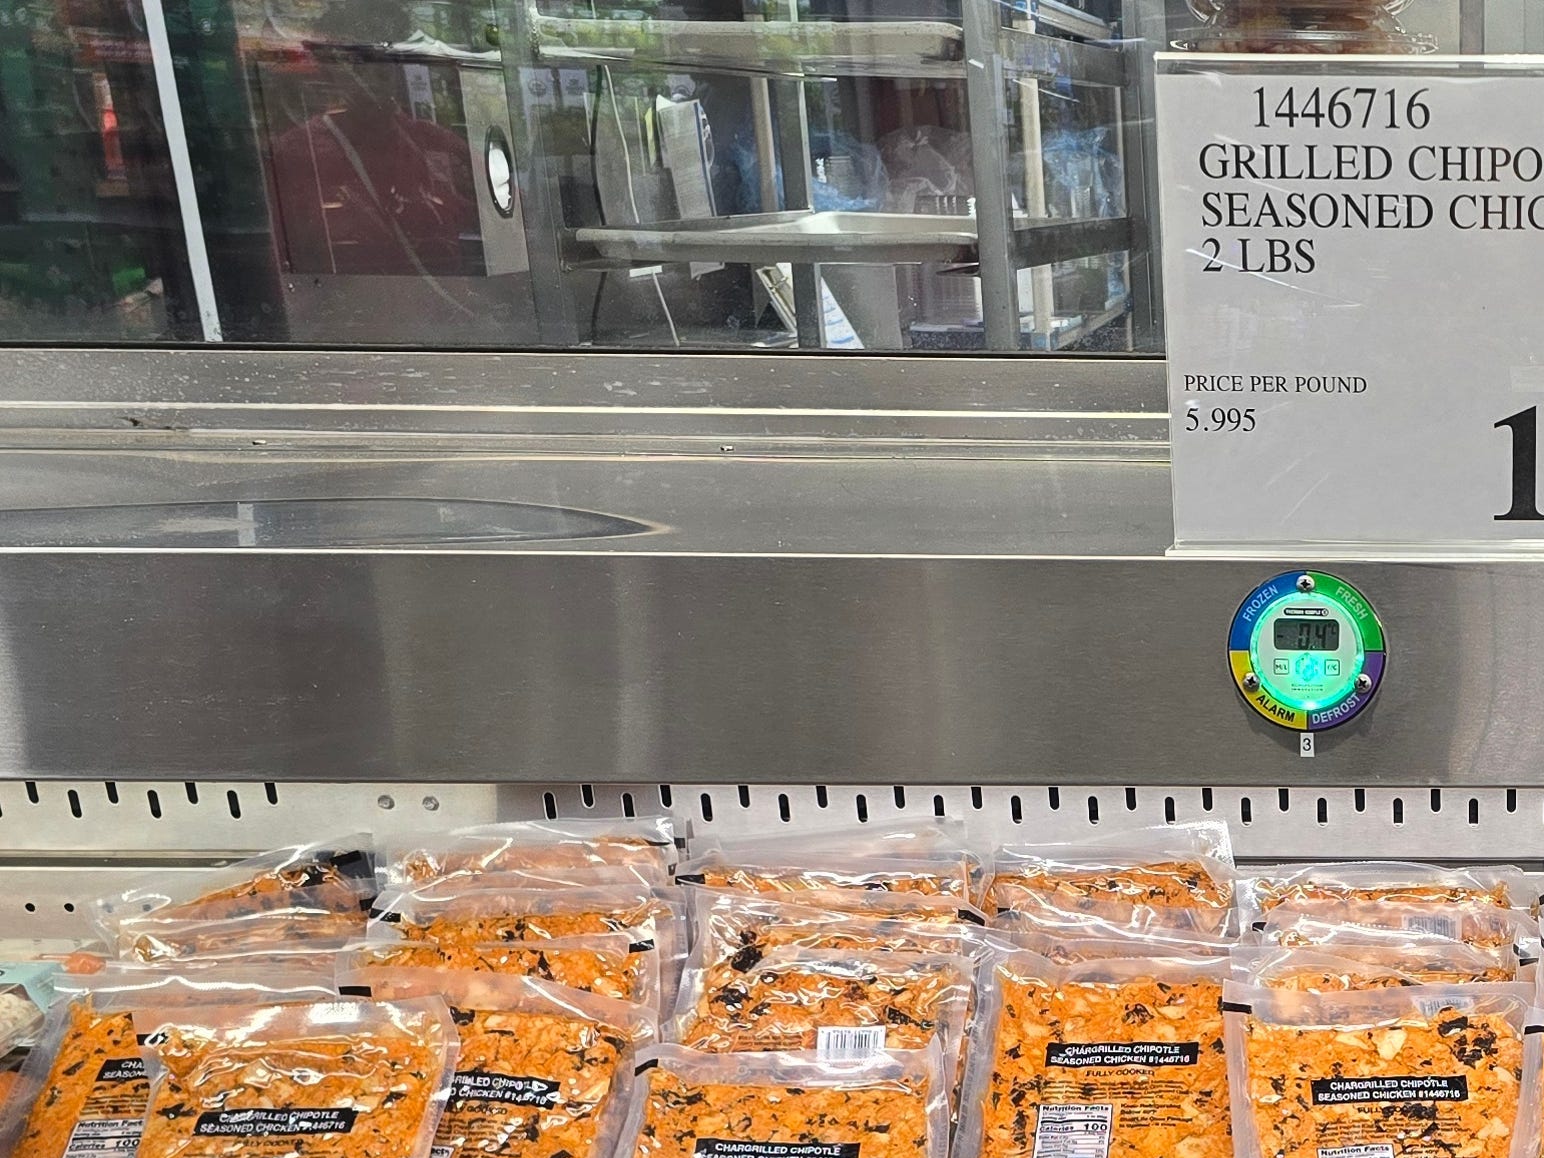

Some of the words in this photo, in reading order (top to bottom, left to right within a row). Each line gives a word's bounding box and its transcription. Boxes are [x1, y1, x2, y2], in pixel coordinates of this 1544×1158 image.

[1255, 86, 1430, 130] 1446716
[1199, 143, 1393, 180] GRILLED
[1201, 191, 1434, 229] SEASONED
[1202, 237, 1224, 272] 2
[1238, 238, 1316, 274] LBS
[1183, 374, 1244, 393] PRICE
[1249, 375, 1289, 393] PER
[1295, 376, 1368, 394] POUND
[1185, 407, 1256, 433] 5.995
[1242, 584, 1279, 623] FROZEN
[1335, 586, 1369, 620] FRESH
[1256, 694, 1296, 722] ALARM
[1312, 693, 1361, 725] DEFROST
[1302, 738, 1311, 751] 3
[1103, 1054, 1147, 1064] CHICKEN
[1133, 1045, 1180, 1055] CHIPOTLE
[1318, 1090, 1371, 1101] SEASONED
[1372, 1090, 1417, 1100] CHICKEN
[1400, 1079, 1449, 1088] CHIPOTLE
[1084, 1123, 1108, 1131] 100
[715, 1142, 789, 1155] CHARGRILLED
[789, 1145, 842, 1157] CHIPOTLE
